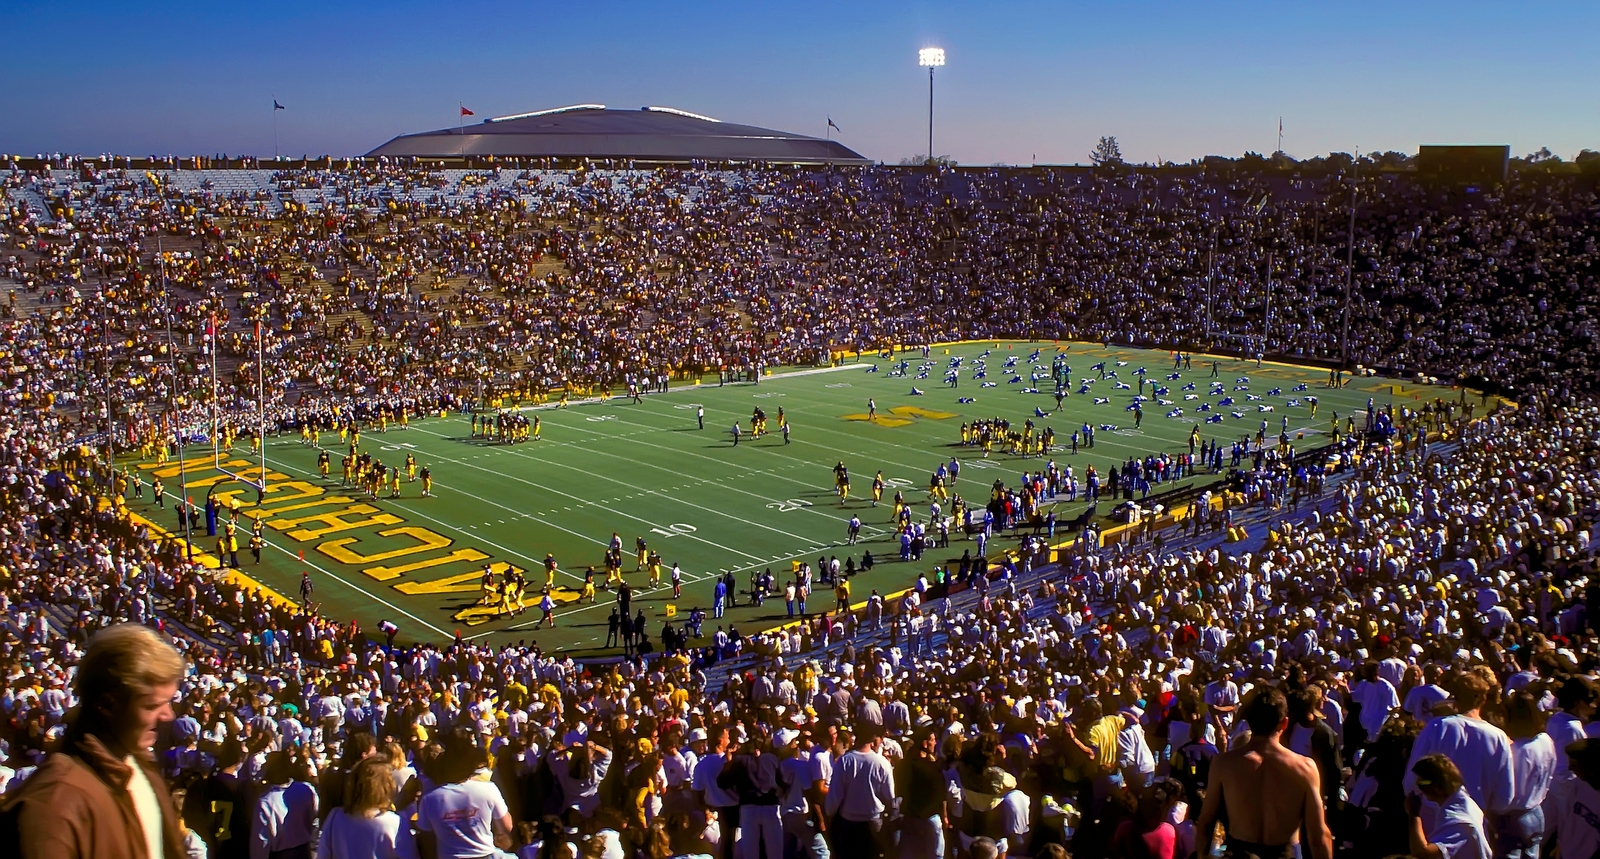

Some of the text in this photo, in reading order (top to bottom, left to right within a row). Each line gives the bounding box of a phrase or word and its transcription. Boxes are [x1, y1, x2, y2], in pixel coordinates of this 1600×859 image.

[836, 405, 962, 428] M
[766, 498, 813, 512] 20
[136, 451, 584, 626] MICHIGAN
[649, 523, 698, 538] 10
[210, 800, 234, 841] 7
